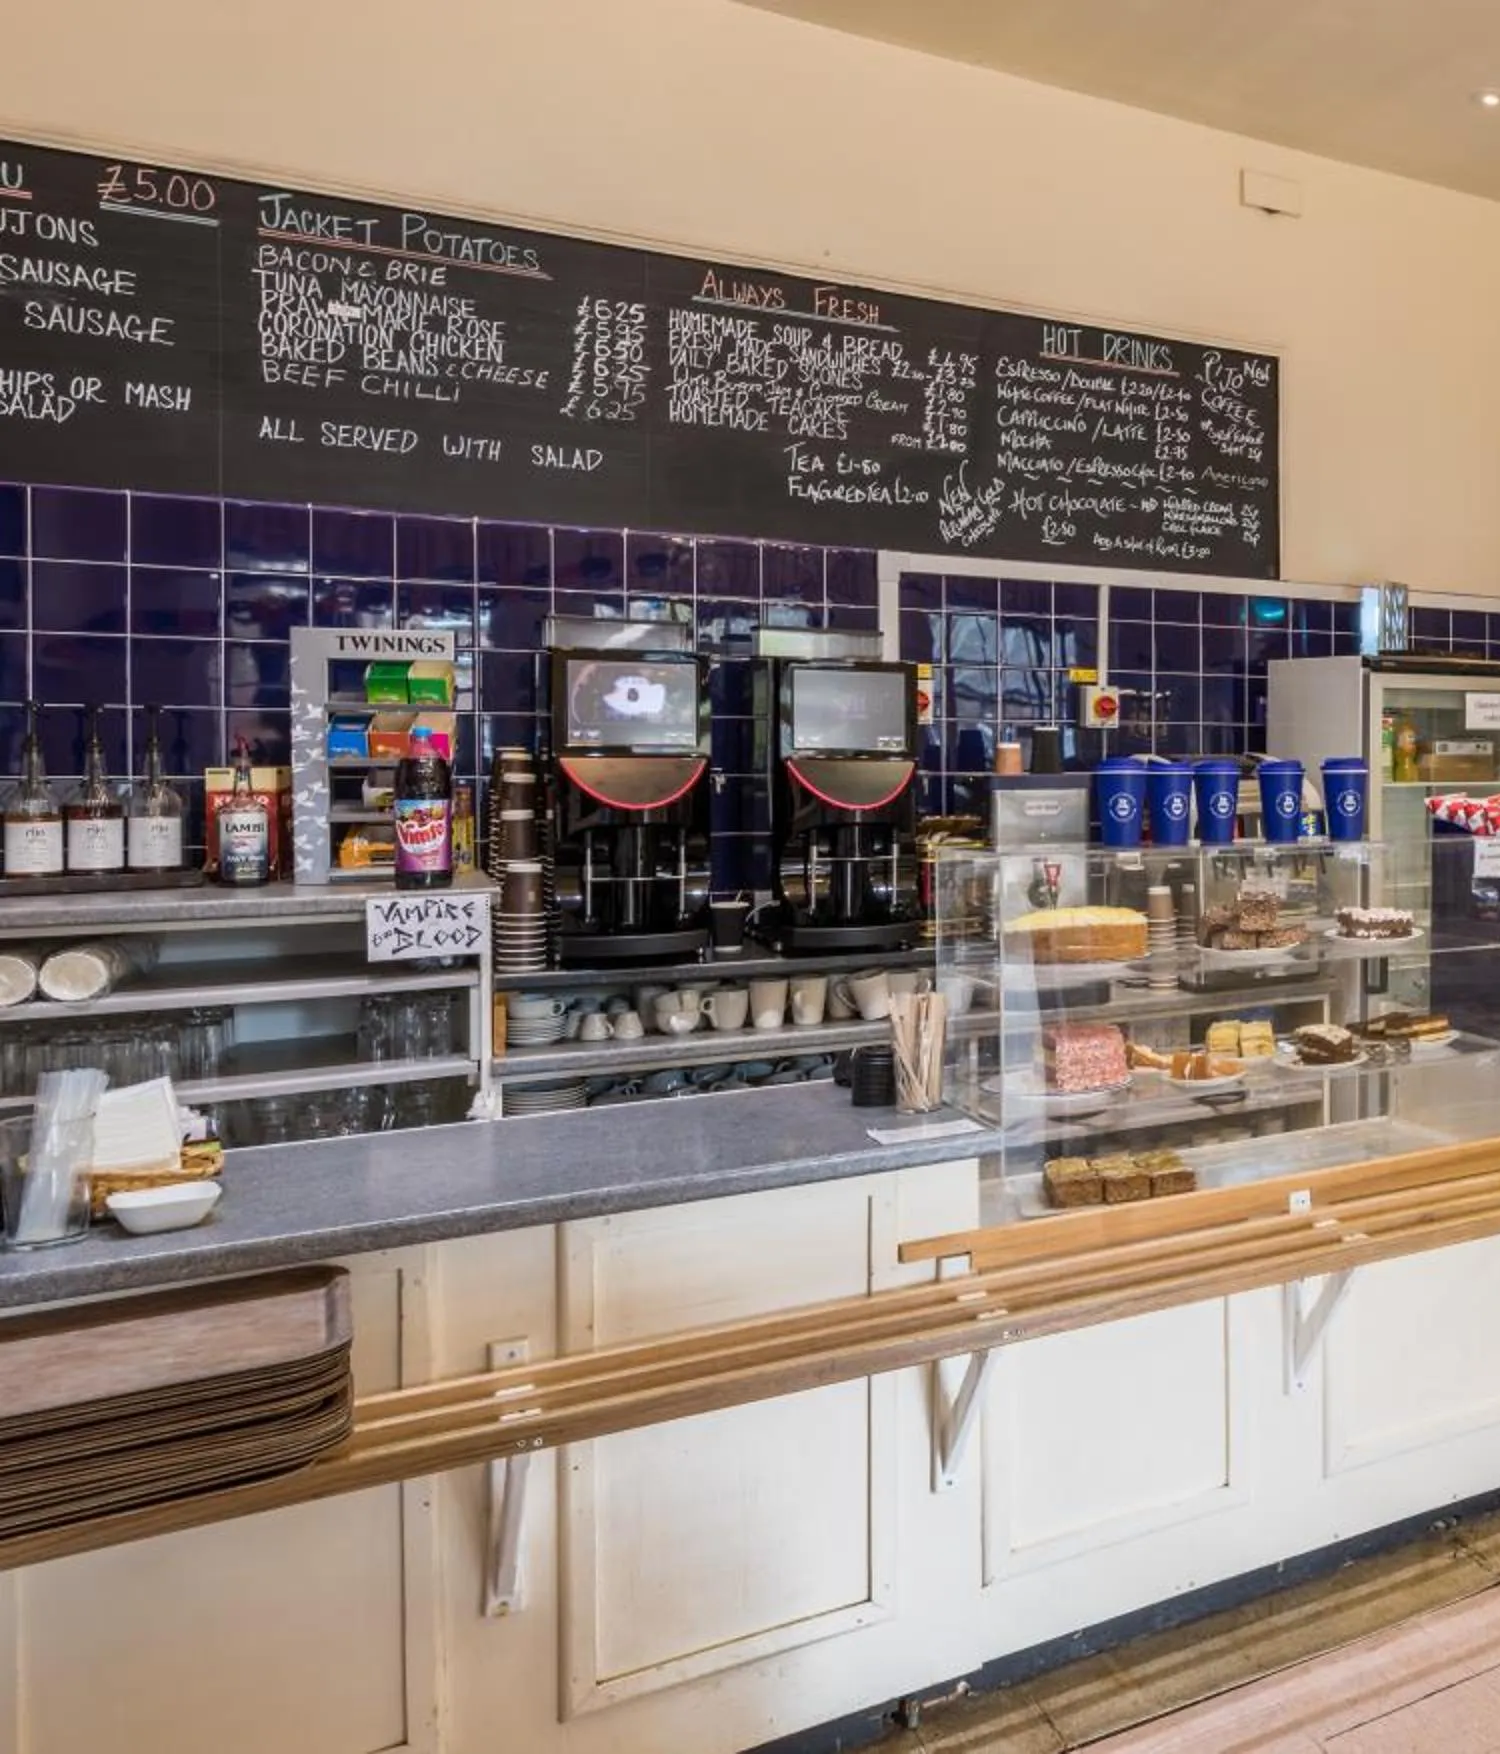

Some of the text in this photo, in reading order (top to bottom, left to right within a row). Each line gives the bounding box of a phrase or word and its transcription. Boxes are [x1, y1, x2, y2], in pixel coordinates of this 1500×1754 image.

[97, 164, 215, 211] £5.00
[258, 193, 539, 272] JACKET POTATOES
[0, 253, 136, 296] SAUSAGE
[259, 244, 350, 276] BACON
[386, 259, 448, 285] BRIE
[252, 268, 478, 319] TUNA MAYONNAISE
[701, 269, 879, 326] ALWAYS FRESH
[24, 301, 175, 346] SAUSAGE
[259, 311, 504, 364] CORONATION CHICKEN
[361, 302, 430, 332] MARIE
[447, 315, 506, 344] ROSE
[669, 308, 760, 340] HOMEMADE
[773, 323, 812, 347] SOUP
[843, 335, 903, 361] BREAD
[261, 332, 345, 363] BAKED
[364, 344, 439, 377] BEANS
[462, 361, 550, 390] CHEESE
[669, 329, 722, 354] FRESH
[736, 337, 776, 363] MADE
[1042, 323, 1174, 372] HOT DRINKS
[263, 360, 349, 388] BEEF
[726, 353, 789, 381] BAKED
[800, 365, 863, 391] SCONES
[70, 376, 106, 402] OR
[125, 381, 193, 411] MASH
[664, 382, 749, 410] TOASTED
[669, 398, 769, 431] HOMEMADE
[788, 414, 848, 440] CAKES
[259, 415, 604, 472] ALL SERVED WITH SALAD
[784, 441, 825, 473] TEA
[1008, 487, 1047, 520] HOT
[335, 635, 446, 653] TWININGS
[391, 924, 482, 954] BLOOD
